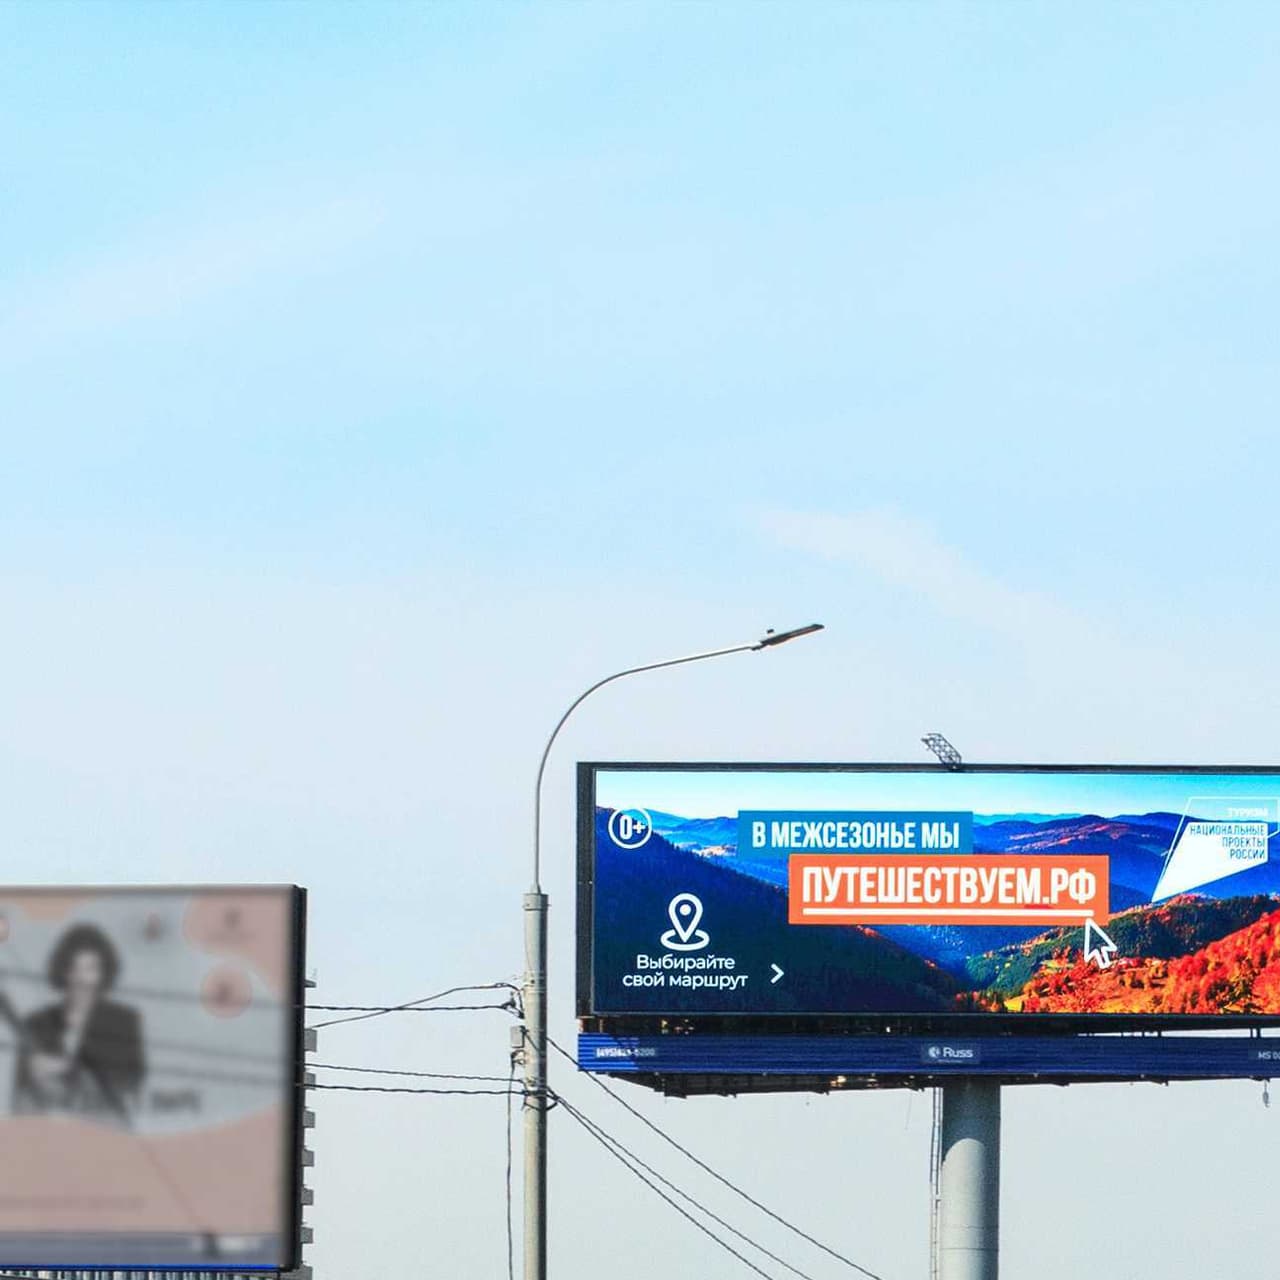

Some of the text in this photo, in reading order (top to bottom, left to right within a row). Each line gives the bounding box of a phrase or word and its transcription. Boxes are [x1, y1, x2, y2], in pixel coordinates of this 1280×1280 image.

[620, 815, 646, 840] 0+
[752, 821, 960, 849] В МЕЖСЕЗОНЬЕ МЫ
[1190, 825, 1265, 836] НАЦИОНАЛЬНЫЕ
[1222, 837, 1265, 847] ПРОЕКТЫ
[1230, 849, 1265, 859] РОССИИ
[802, 866, 1097, 904] ПУТЕШЕСТВУЕМ.РФ
[636, 953, 735, 972] Выбирайте
[622, 971, 748, 990] свой маршрут
[943, 1047, 974, 1058] Russ
